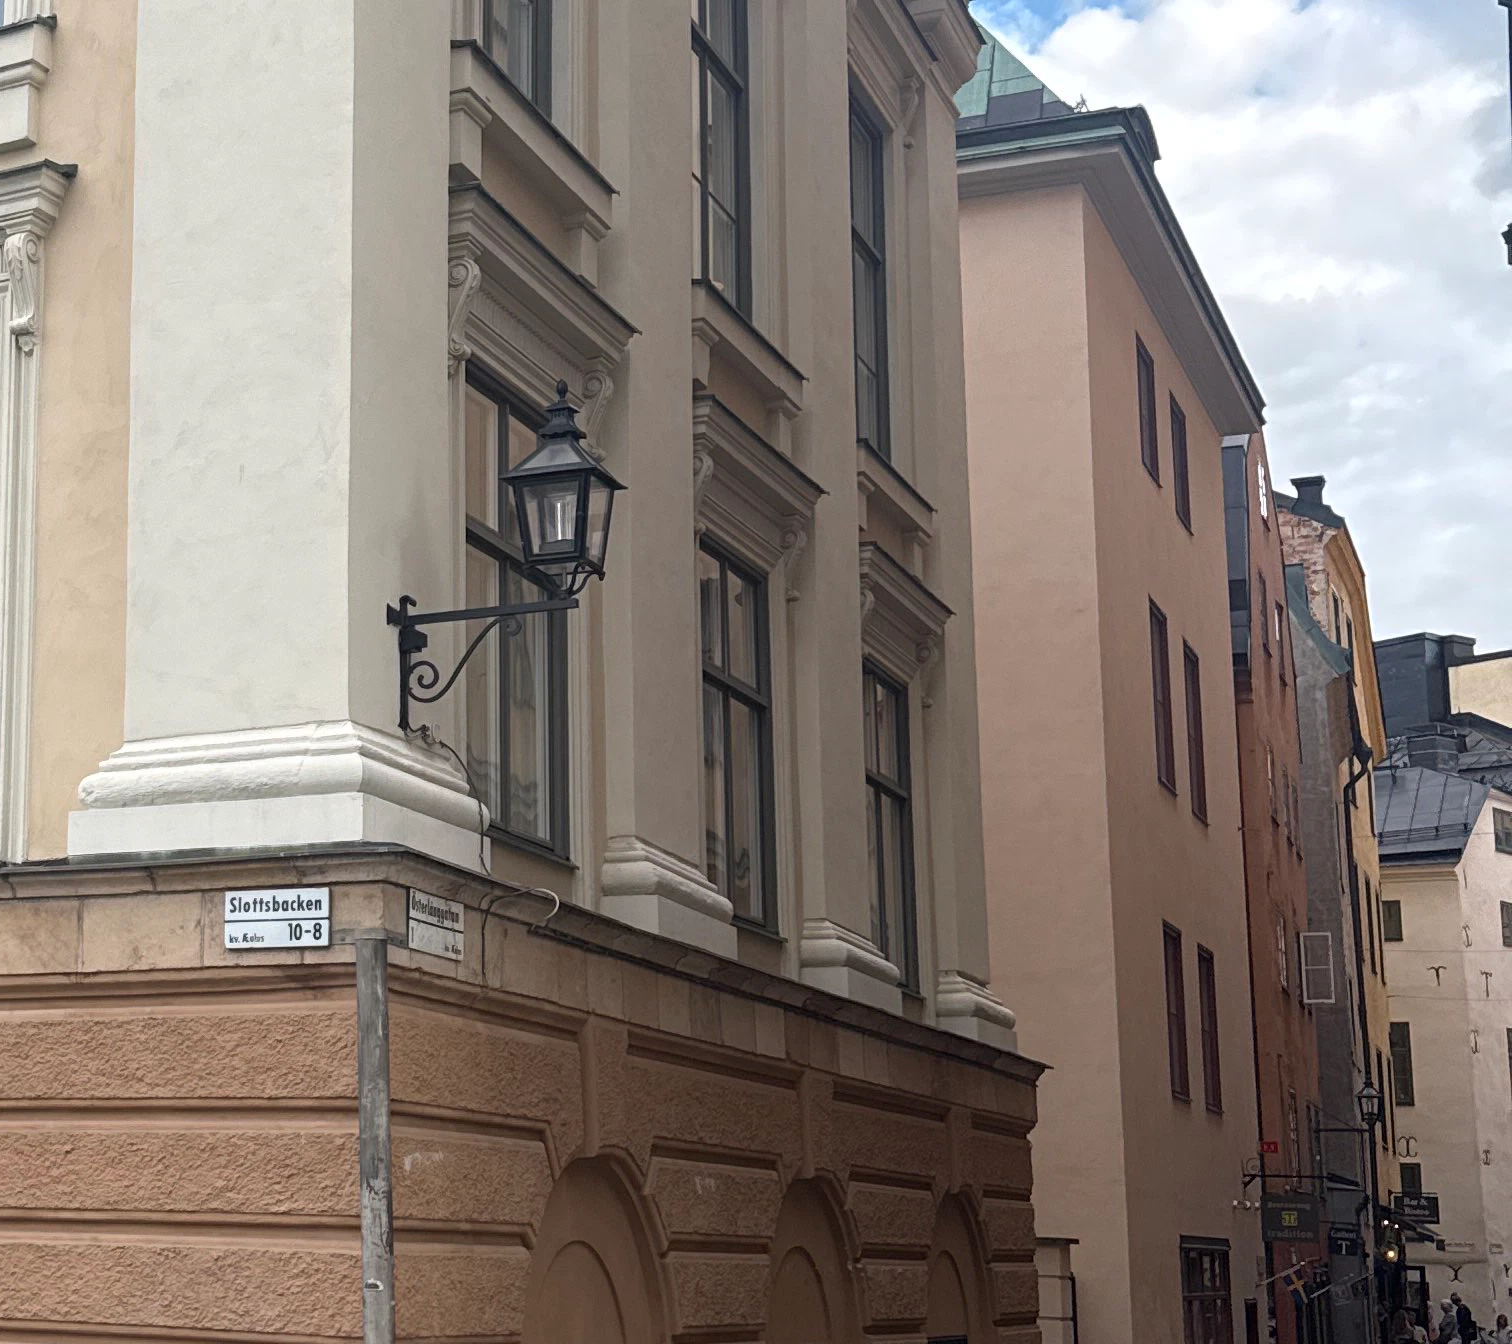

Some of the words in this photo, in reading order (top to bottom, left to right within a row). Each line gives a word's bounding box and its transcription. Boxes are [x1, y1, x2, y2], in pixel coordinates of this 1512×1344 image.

[229, 894, 322, 913] Slottsbacken
[411, 891, 459, 924] Österlånggatan
[287, 922, 323, 941] 10-8
